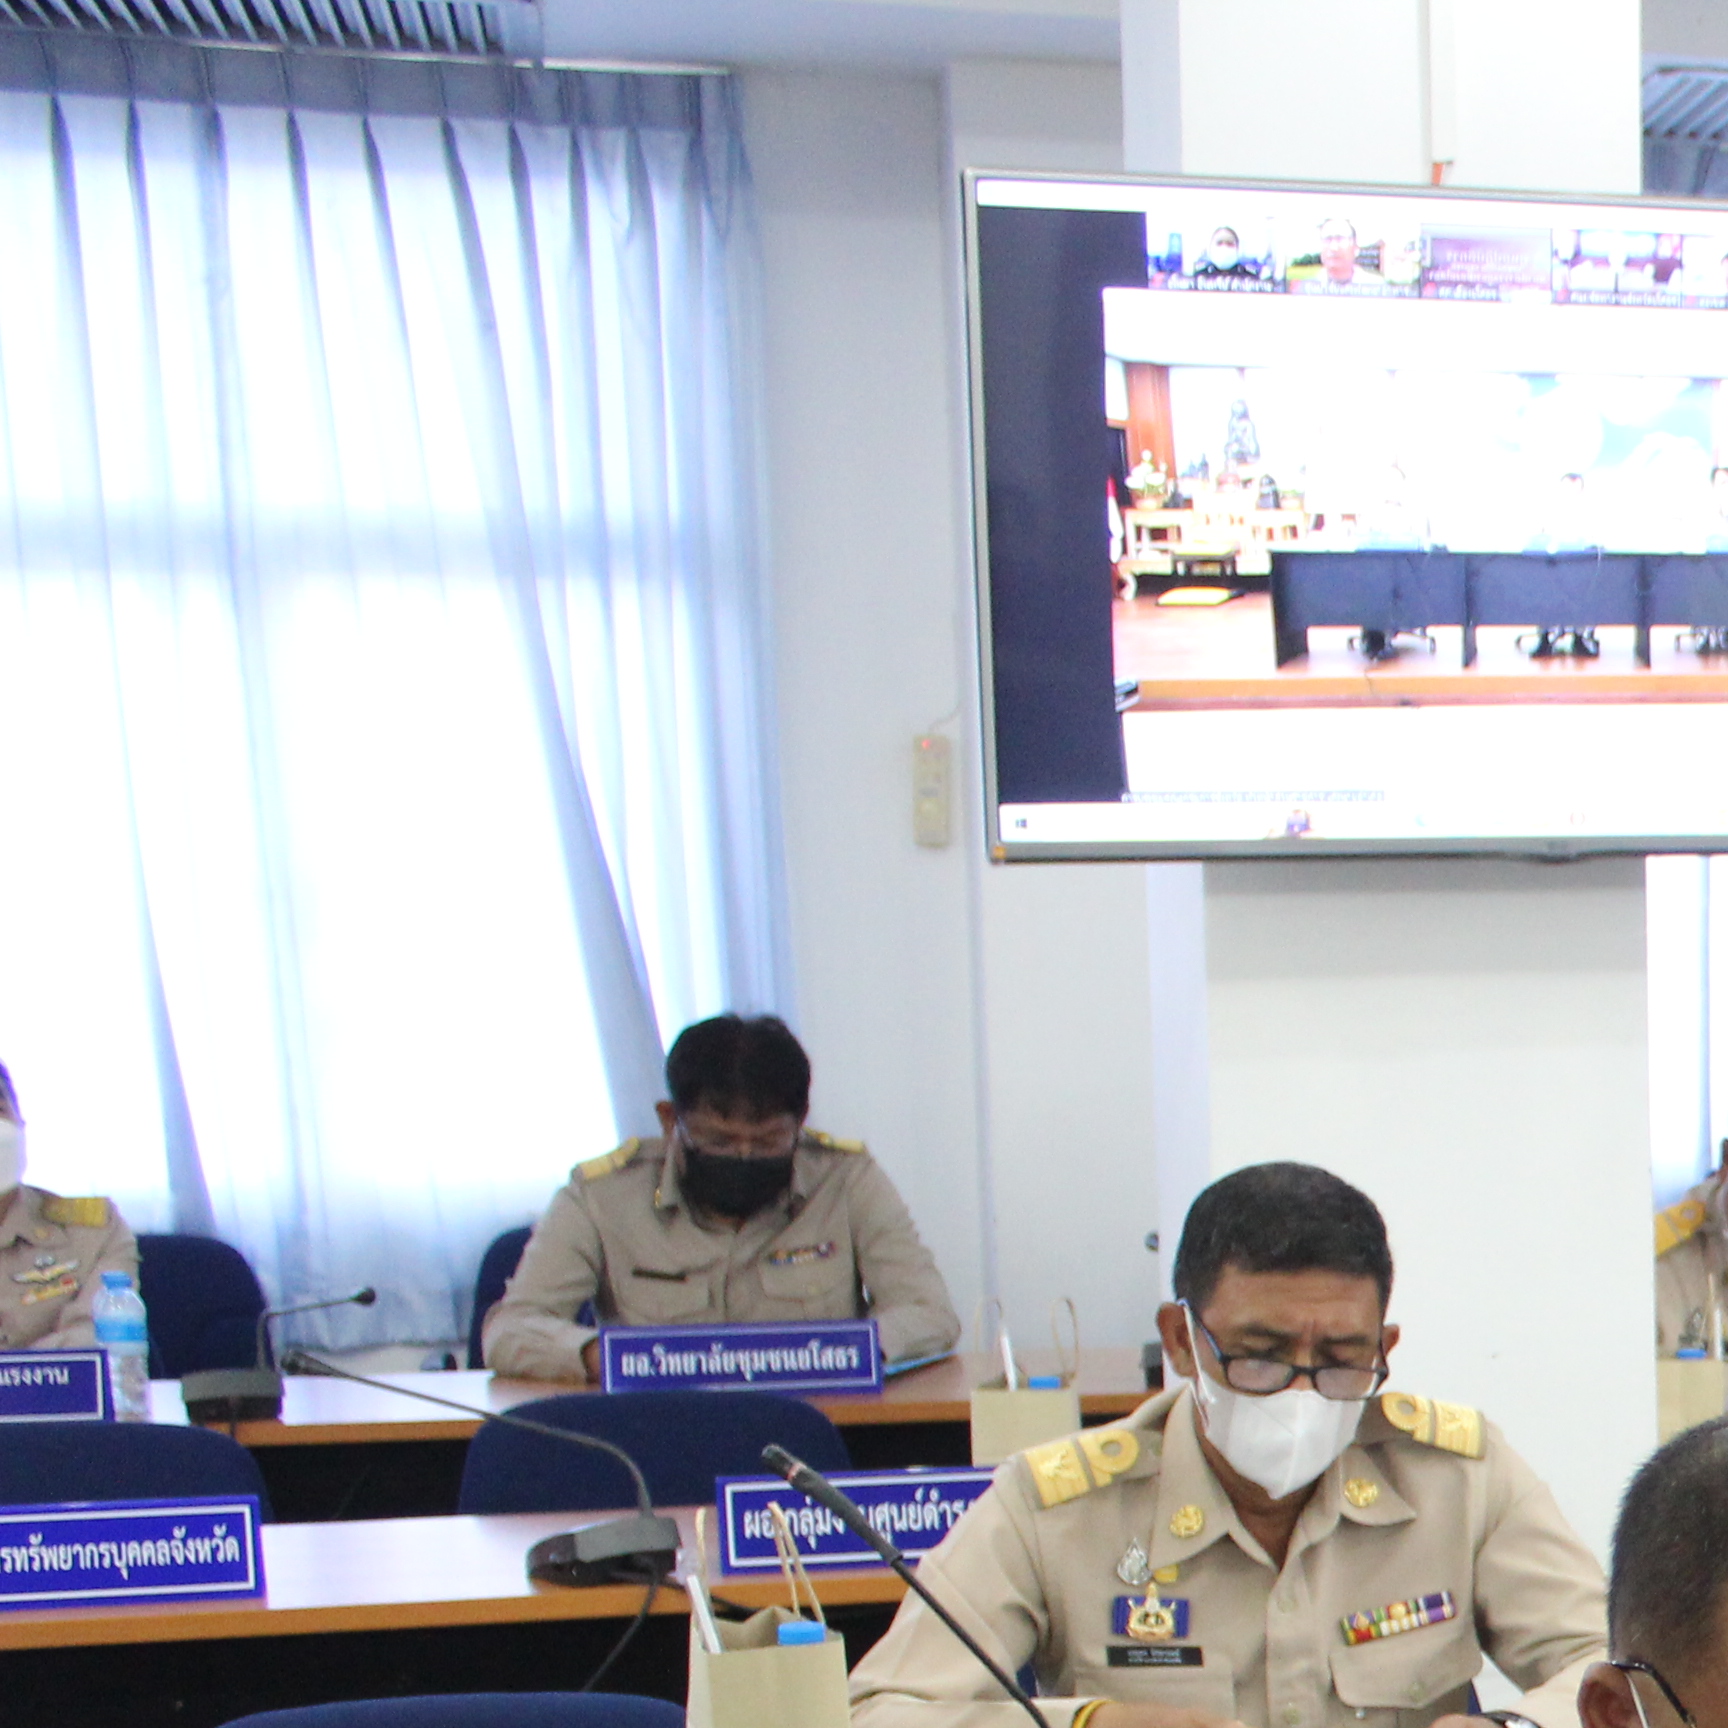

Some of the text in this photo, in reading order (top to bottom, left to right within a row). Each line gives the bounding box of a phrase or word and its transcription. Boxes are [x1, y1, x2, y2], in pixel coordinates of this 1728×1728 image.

[0, 1523, 241, 1582] รทรัพยากรบุคคลจังหวัด
